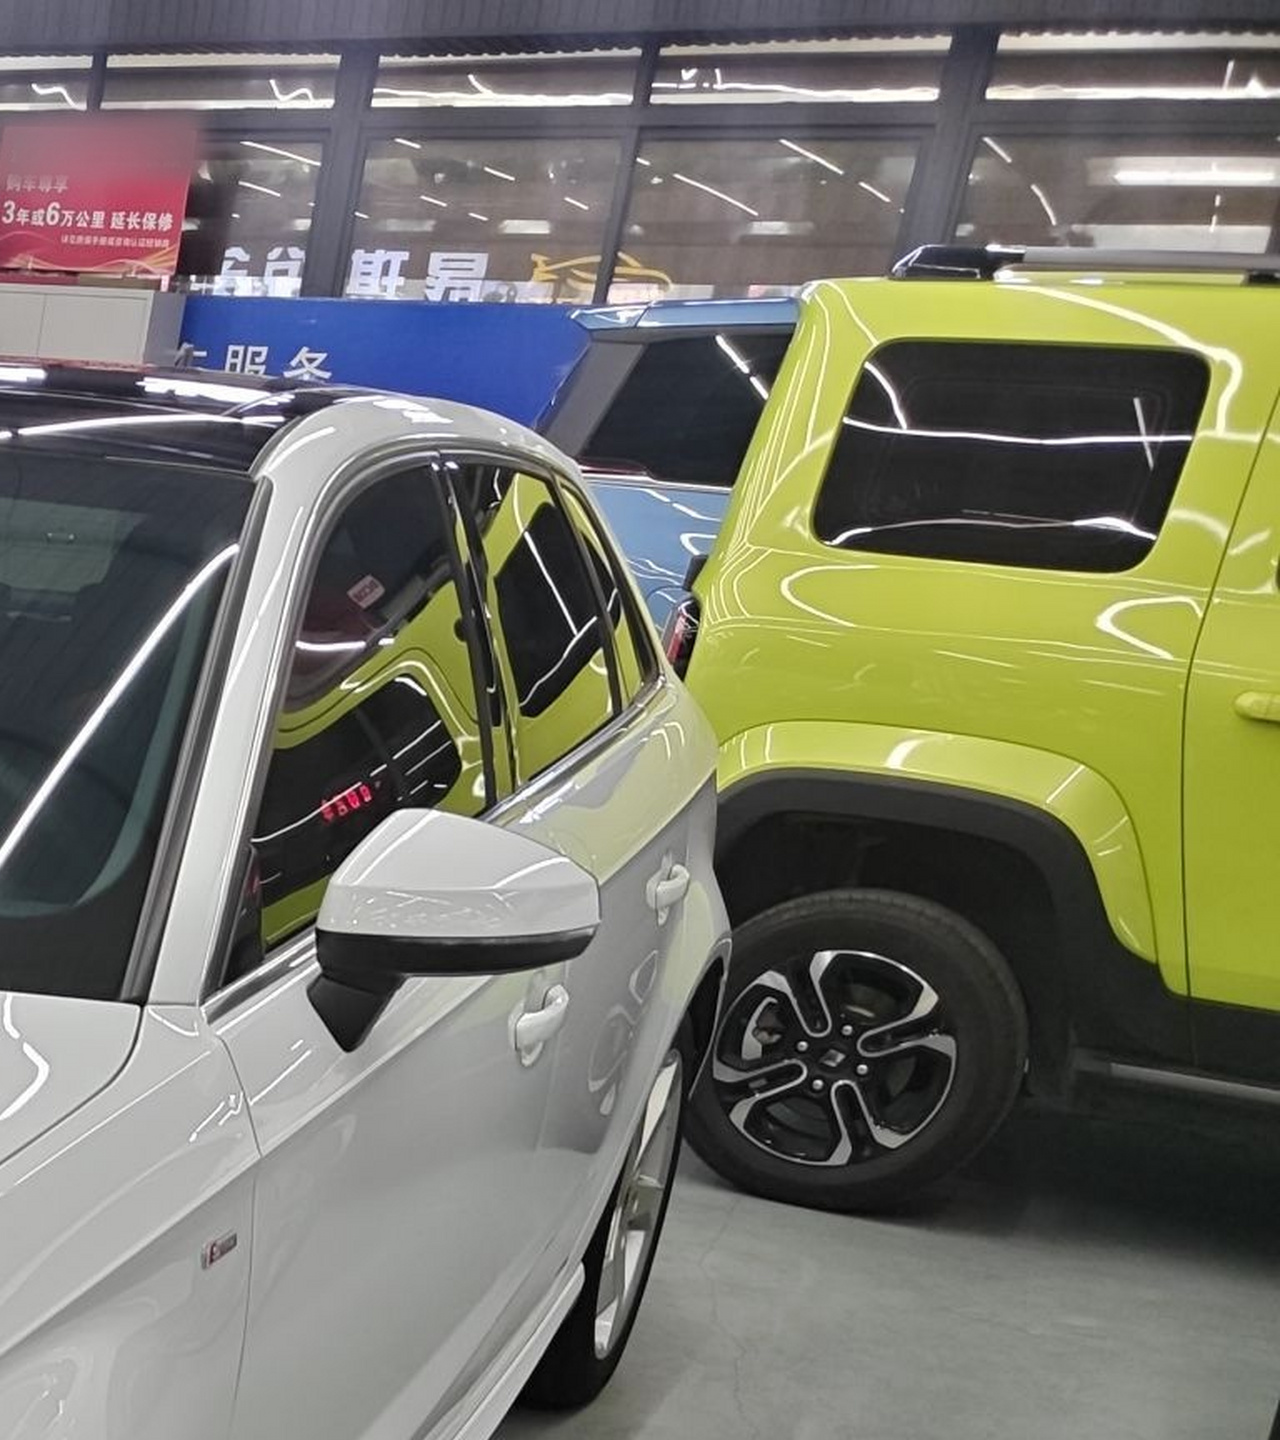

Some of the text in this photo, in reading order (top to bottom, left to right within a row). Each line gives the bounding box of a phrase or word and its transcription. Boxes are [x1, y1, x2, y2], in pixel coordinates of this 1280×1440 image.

[1, 200, 174, 231] 3年或6万公里 延长保修
